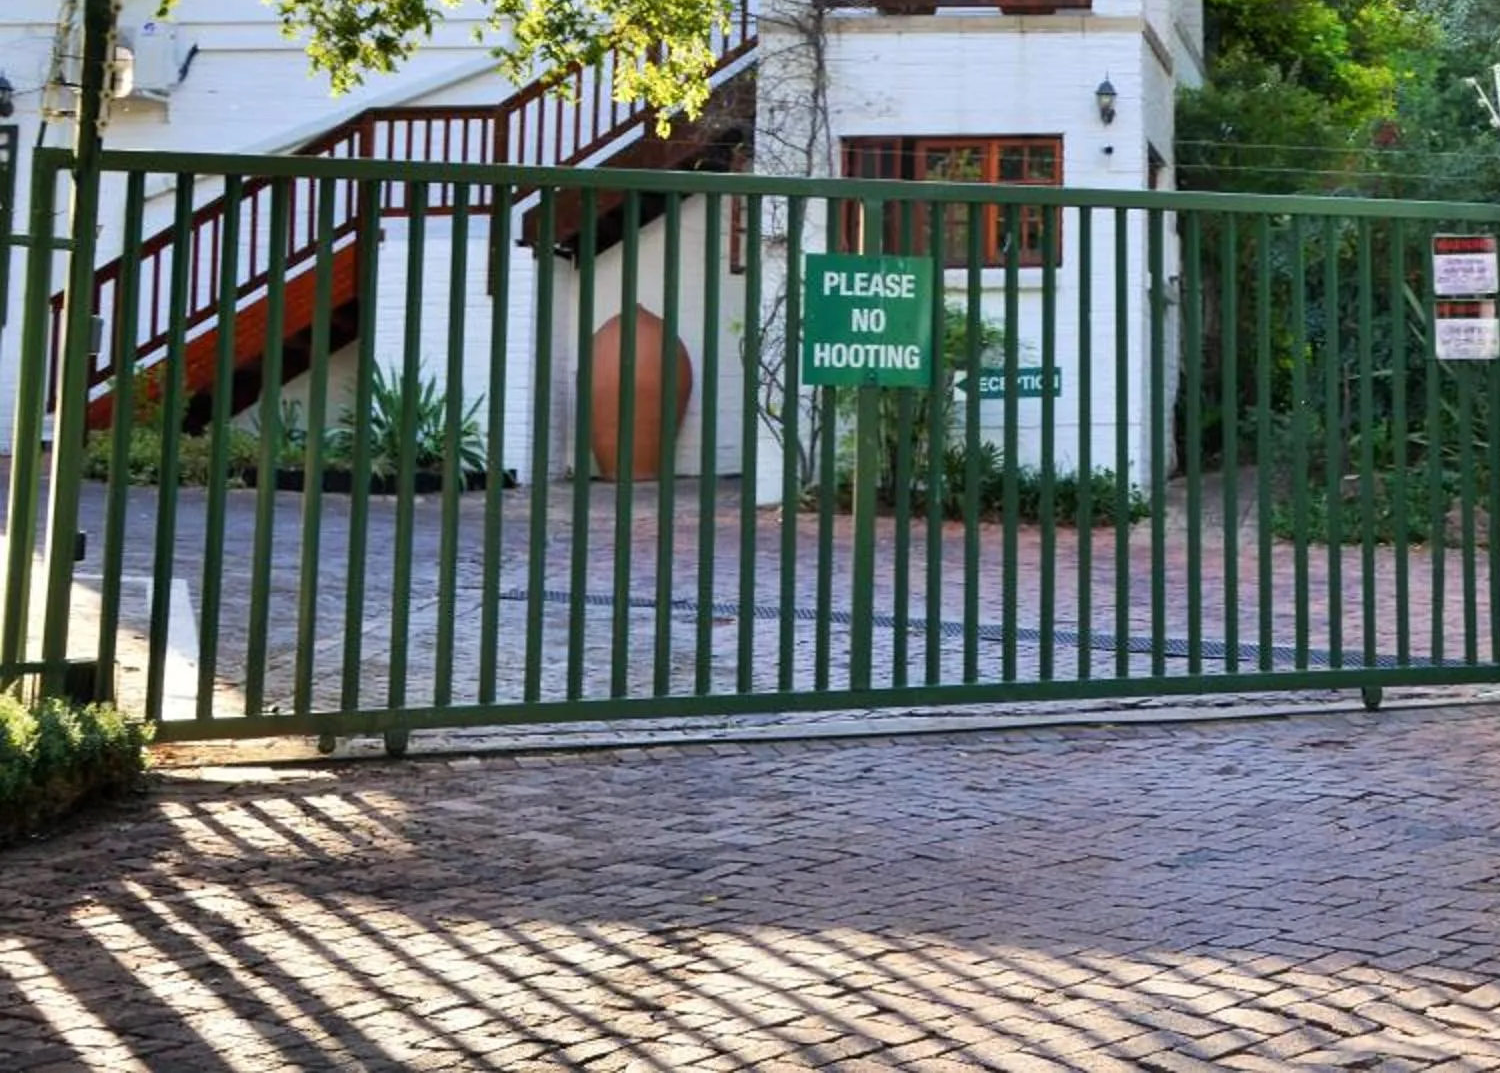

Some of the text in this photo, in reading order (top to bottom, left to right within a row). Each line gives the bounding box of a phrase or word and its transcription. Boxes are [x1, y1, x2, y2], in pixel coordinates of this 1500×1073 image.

[823, 271, 916, 298] PLEASE
[851, 308, 886, 332] NO
[813, 343, 920, 370] HOOTING
